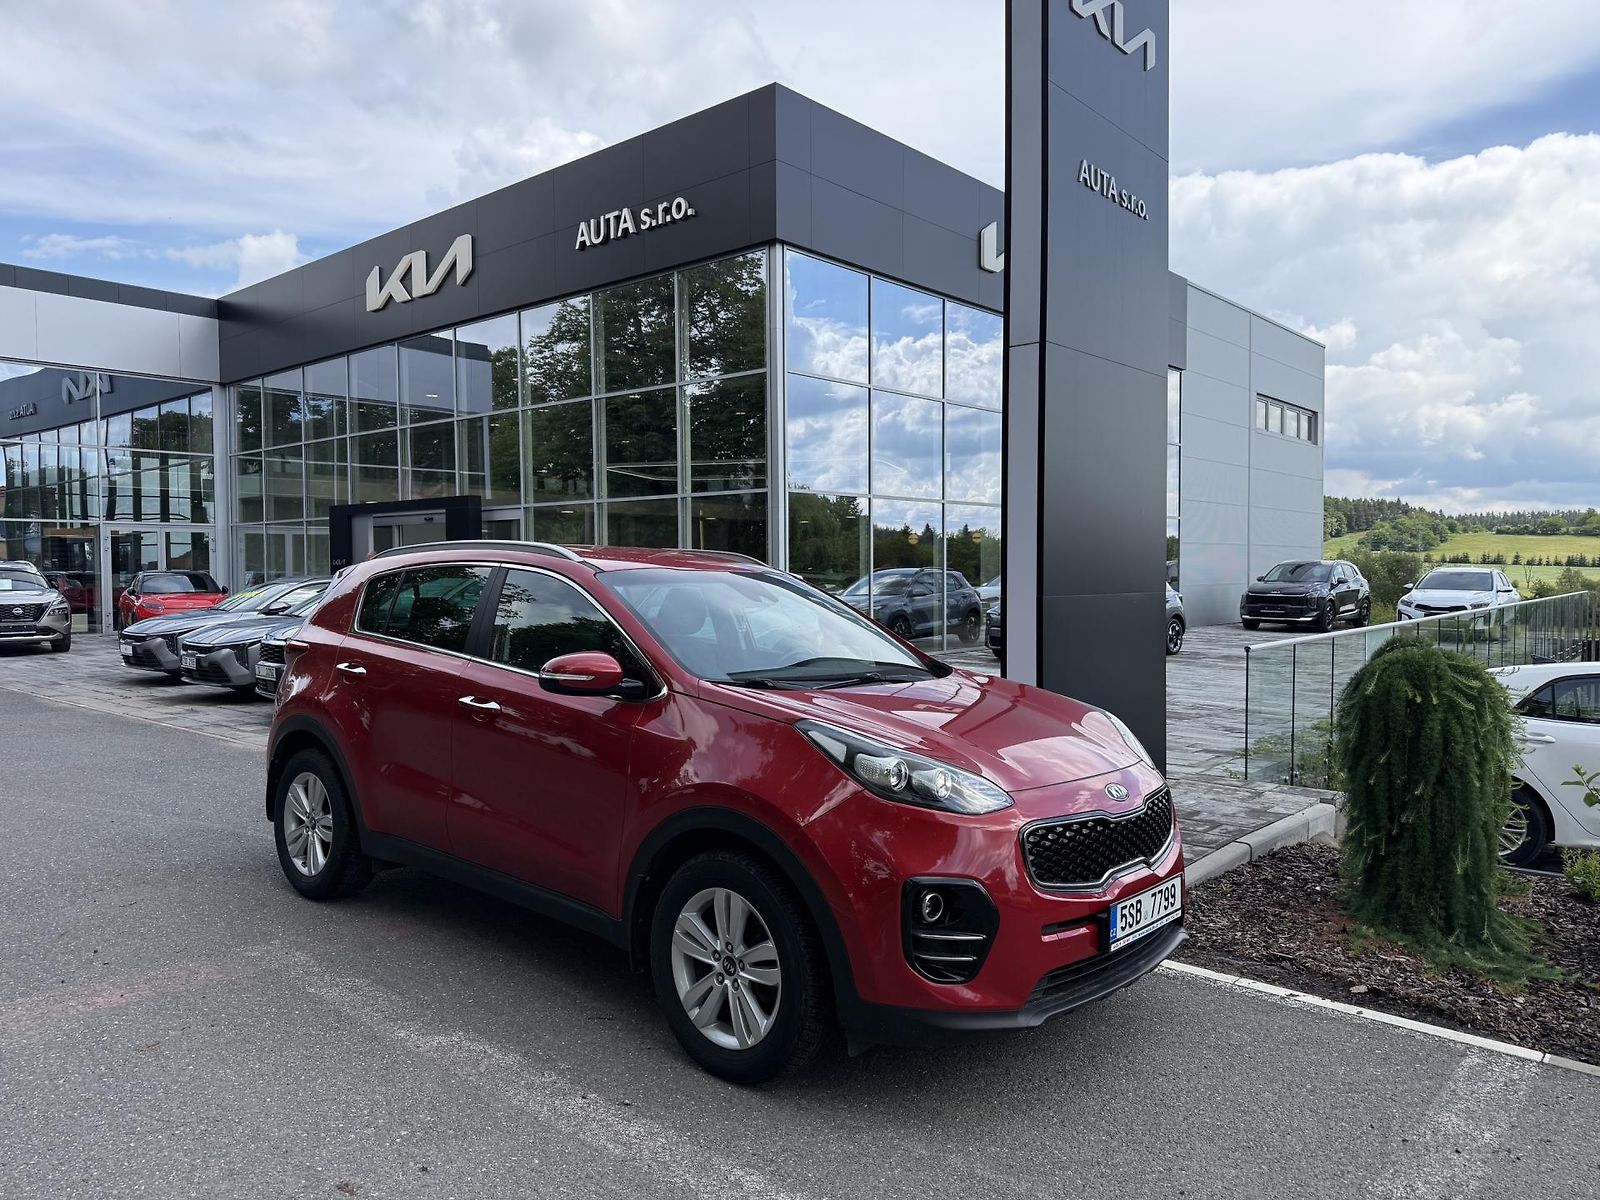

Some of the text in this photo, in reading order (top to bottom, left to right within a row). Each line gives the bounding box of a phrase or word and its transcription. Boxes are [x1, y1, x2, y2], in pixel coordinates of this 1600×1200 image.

[1078, 159, 1149, 220] AUTA s.r.o.
[575, 196, 696, 250] AUTA s.r.o.
[366, 233, 475, 312] KIA
[1110, 927, 1117, 938] CZ
[1120, 898, 1143, 931] 5SB
[1150, 883, 1176, 919] 7799
